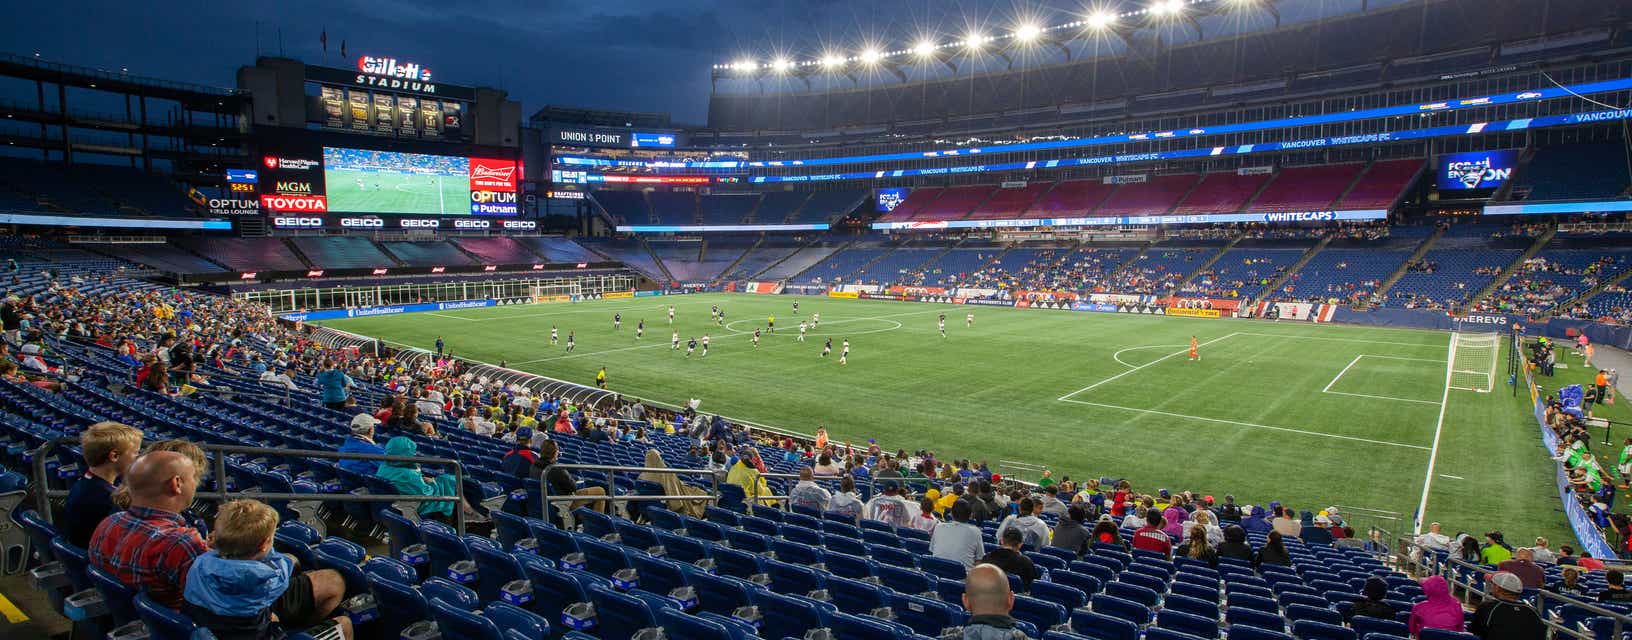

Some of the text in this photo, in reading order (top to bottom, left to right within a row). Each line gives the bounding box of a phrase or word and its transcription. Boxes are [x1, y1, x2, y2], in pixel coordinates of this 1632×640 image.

[359, 56, 431, 80] Gillette
[355, 74, 436, 93] STADIUM
[560, 131, 587, 141] UNION
[595, 134, 621, 144] POINT
[1281, 138, 1326, 149] VANCOUVER
[1331, 133, 1378, 145] WHITECAPS
[1079, 156, 1112, 165] VANCOUVER
[277, 181, 311, 192] MGM
[471, 191, 516, 202] OPTUM
[209, 199, 259, 209] OPTUM
[264, 198, 325, 209] TOYOTA
[480, 205, 517, 214] Putnam
[1268, 211, 1332, 222] WHITECAPS
[274, 217, 322, 227] GEICO
[340, 218, 383, 227] GEICO
[400, 220, 440, 228] GEICO
[455, 220, 490, 228] GEICO
[503, 221, 536, 229] GEICO
